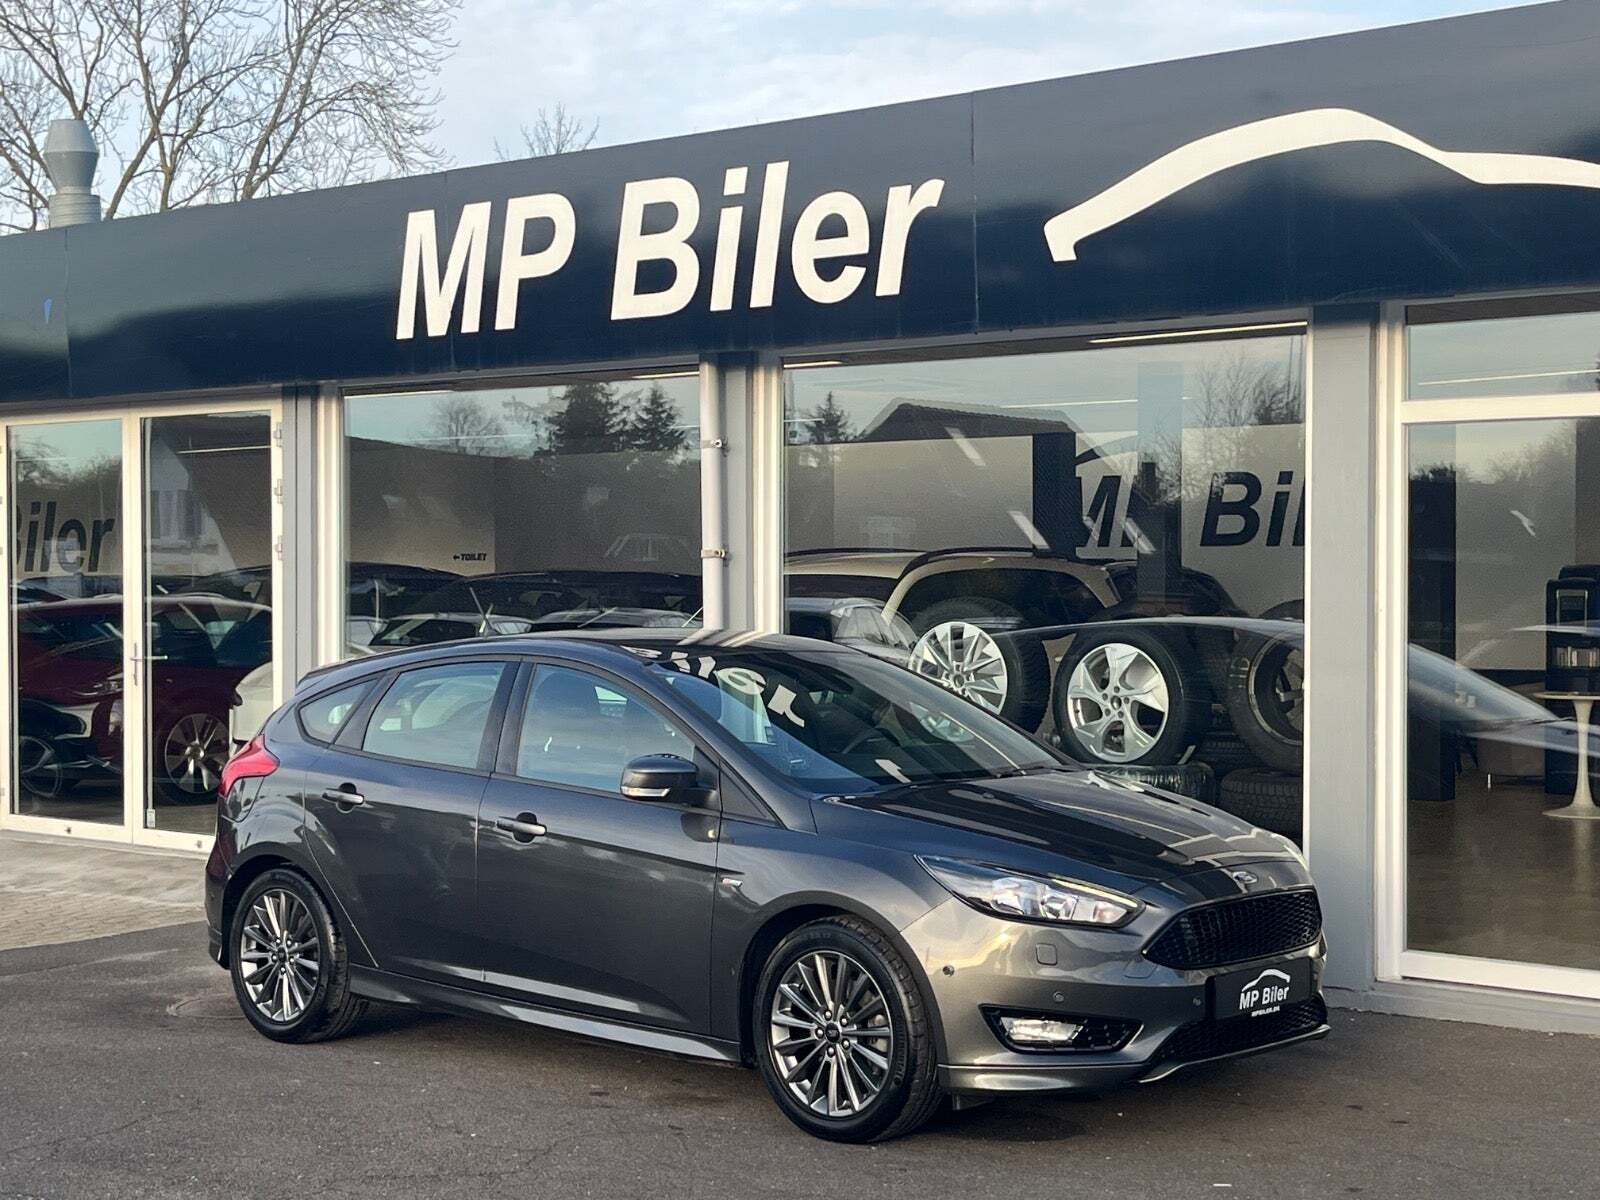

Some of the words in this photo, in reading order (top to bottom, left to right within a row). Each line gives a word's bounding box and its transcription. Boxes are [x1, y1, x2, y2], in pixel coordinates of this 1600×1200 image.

[396, 193, 576, 340] MP
[611, 161, 945, 320] Biler
[16, 501, 116, 572] iler
[460, 552, 487, 561] TOILET
[1239, 990, 1260, 1010] MP
[1261, 985, 1290, 1005] Biler
